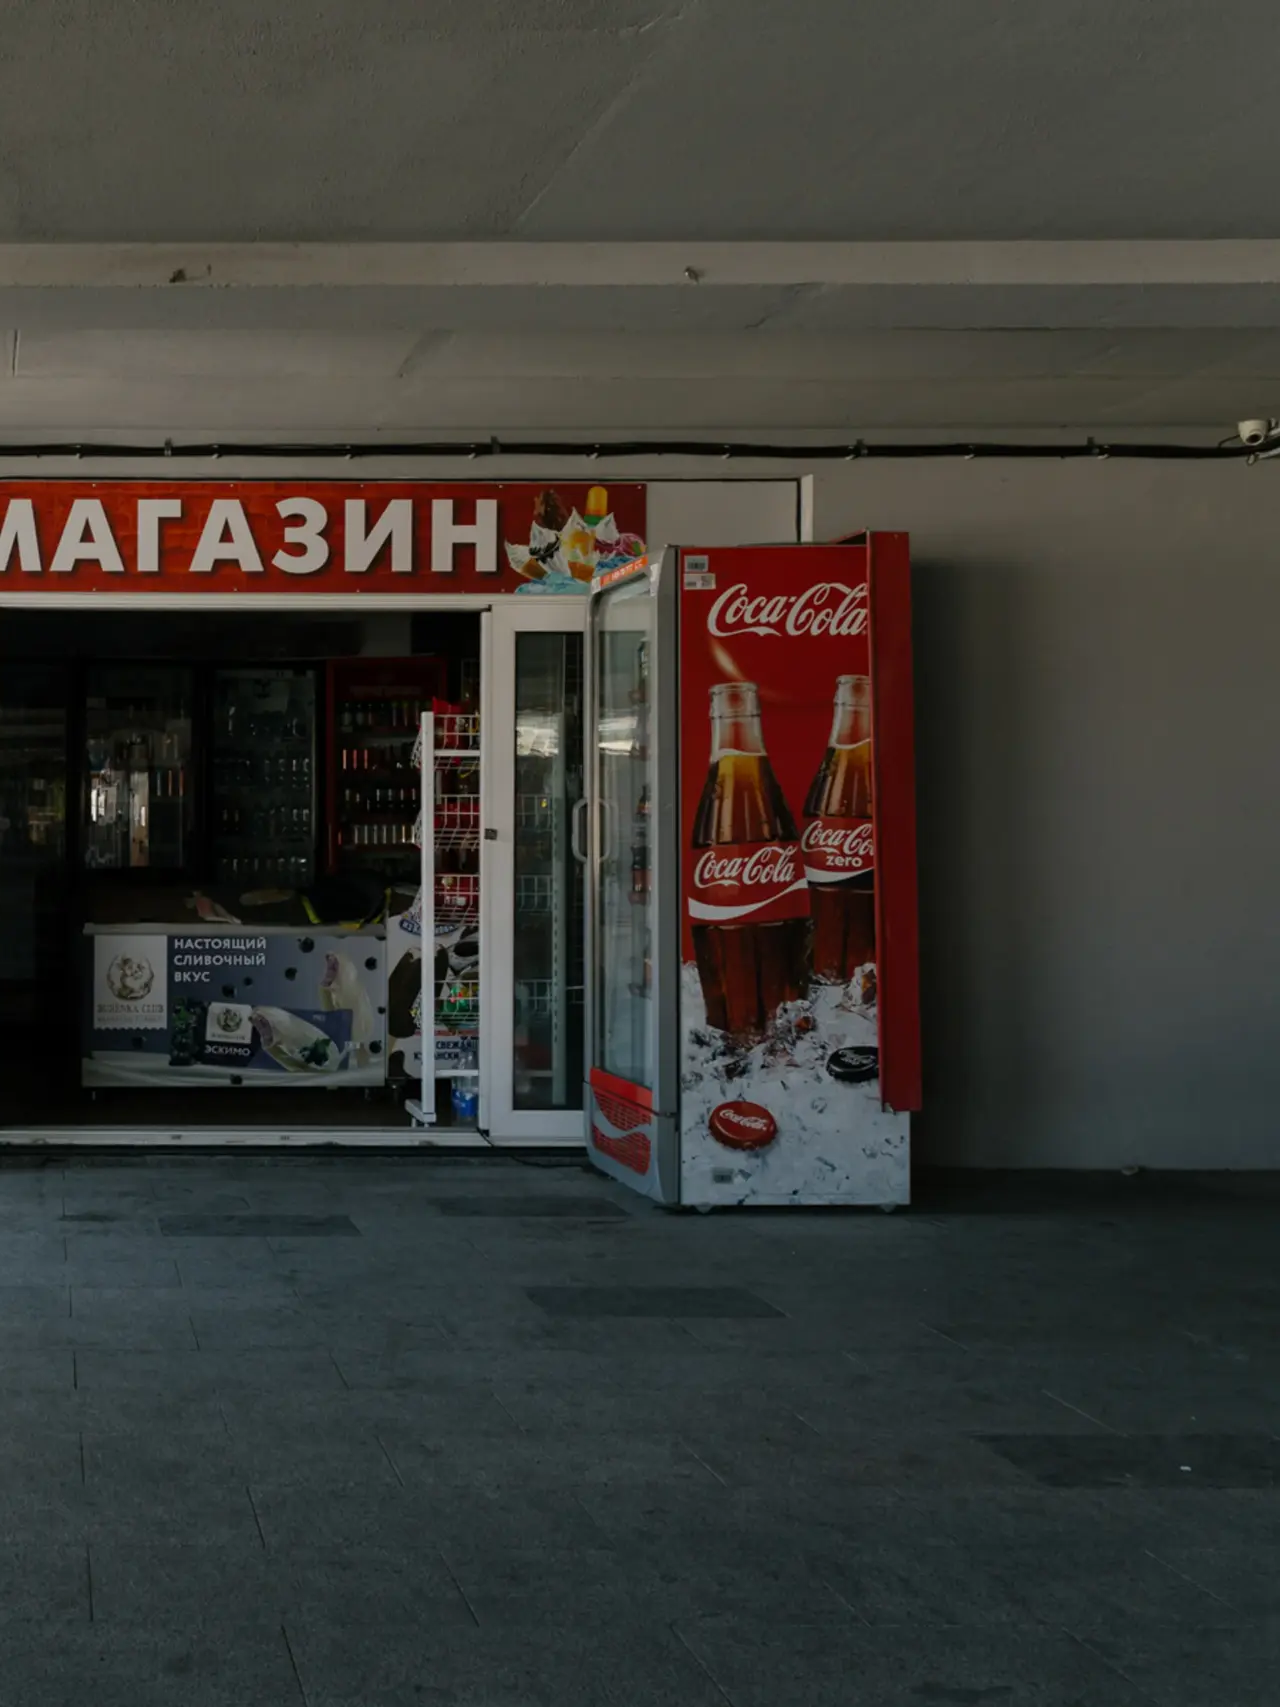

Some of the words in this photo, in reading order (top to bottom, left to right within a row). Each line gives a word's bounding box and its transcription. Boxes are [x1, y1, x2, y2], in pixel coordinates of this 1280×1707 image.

[707, 582, 868, 637] Coca-Cola
[801, 820, 874, 856] Coca-Co
[694, 845, 798, 888] Coca-Cola
[826, 855, 862, 867] zero
[174, 937, 267, 950] НАСТОЯЩИЙ
[174, 953, 266, 966] СЛИВОЧНЫЙ
[174, 971, 210, 983] ВКУС
[205, 1045, 251, 1057] ЭСКИМО
